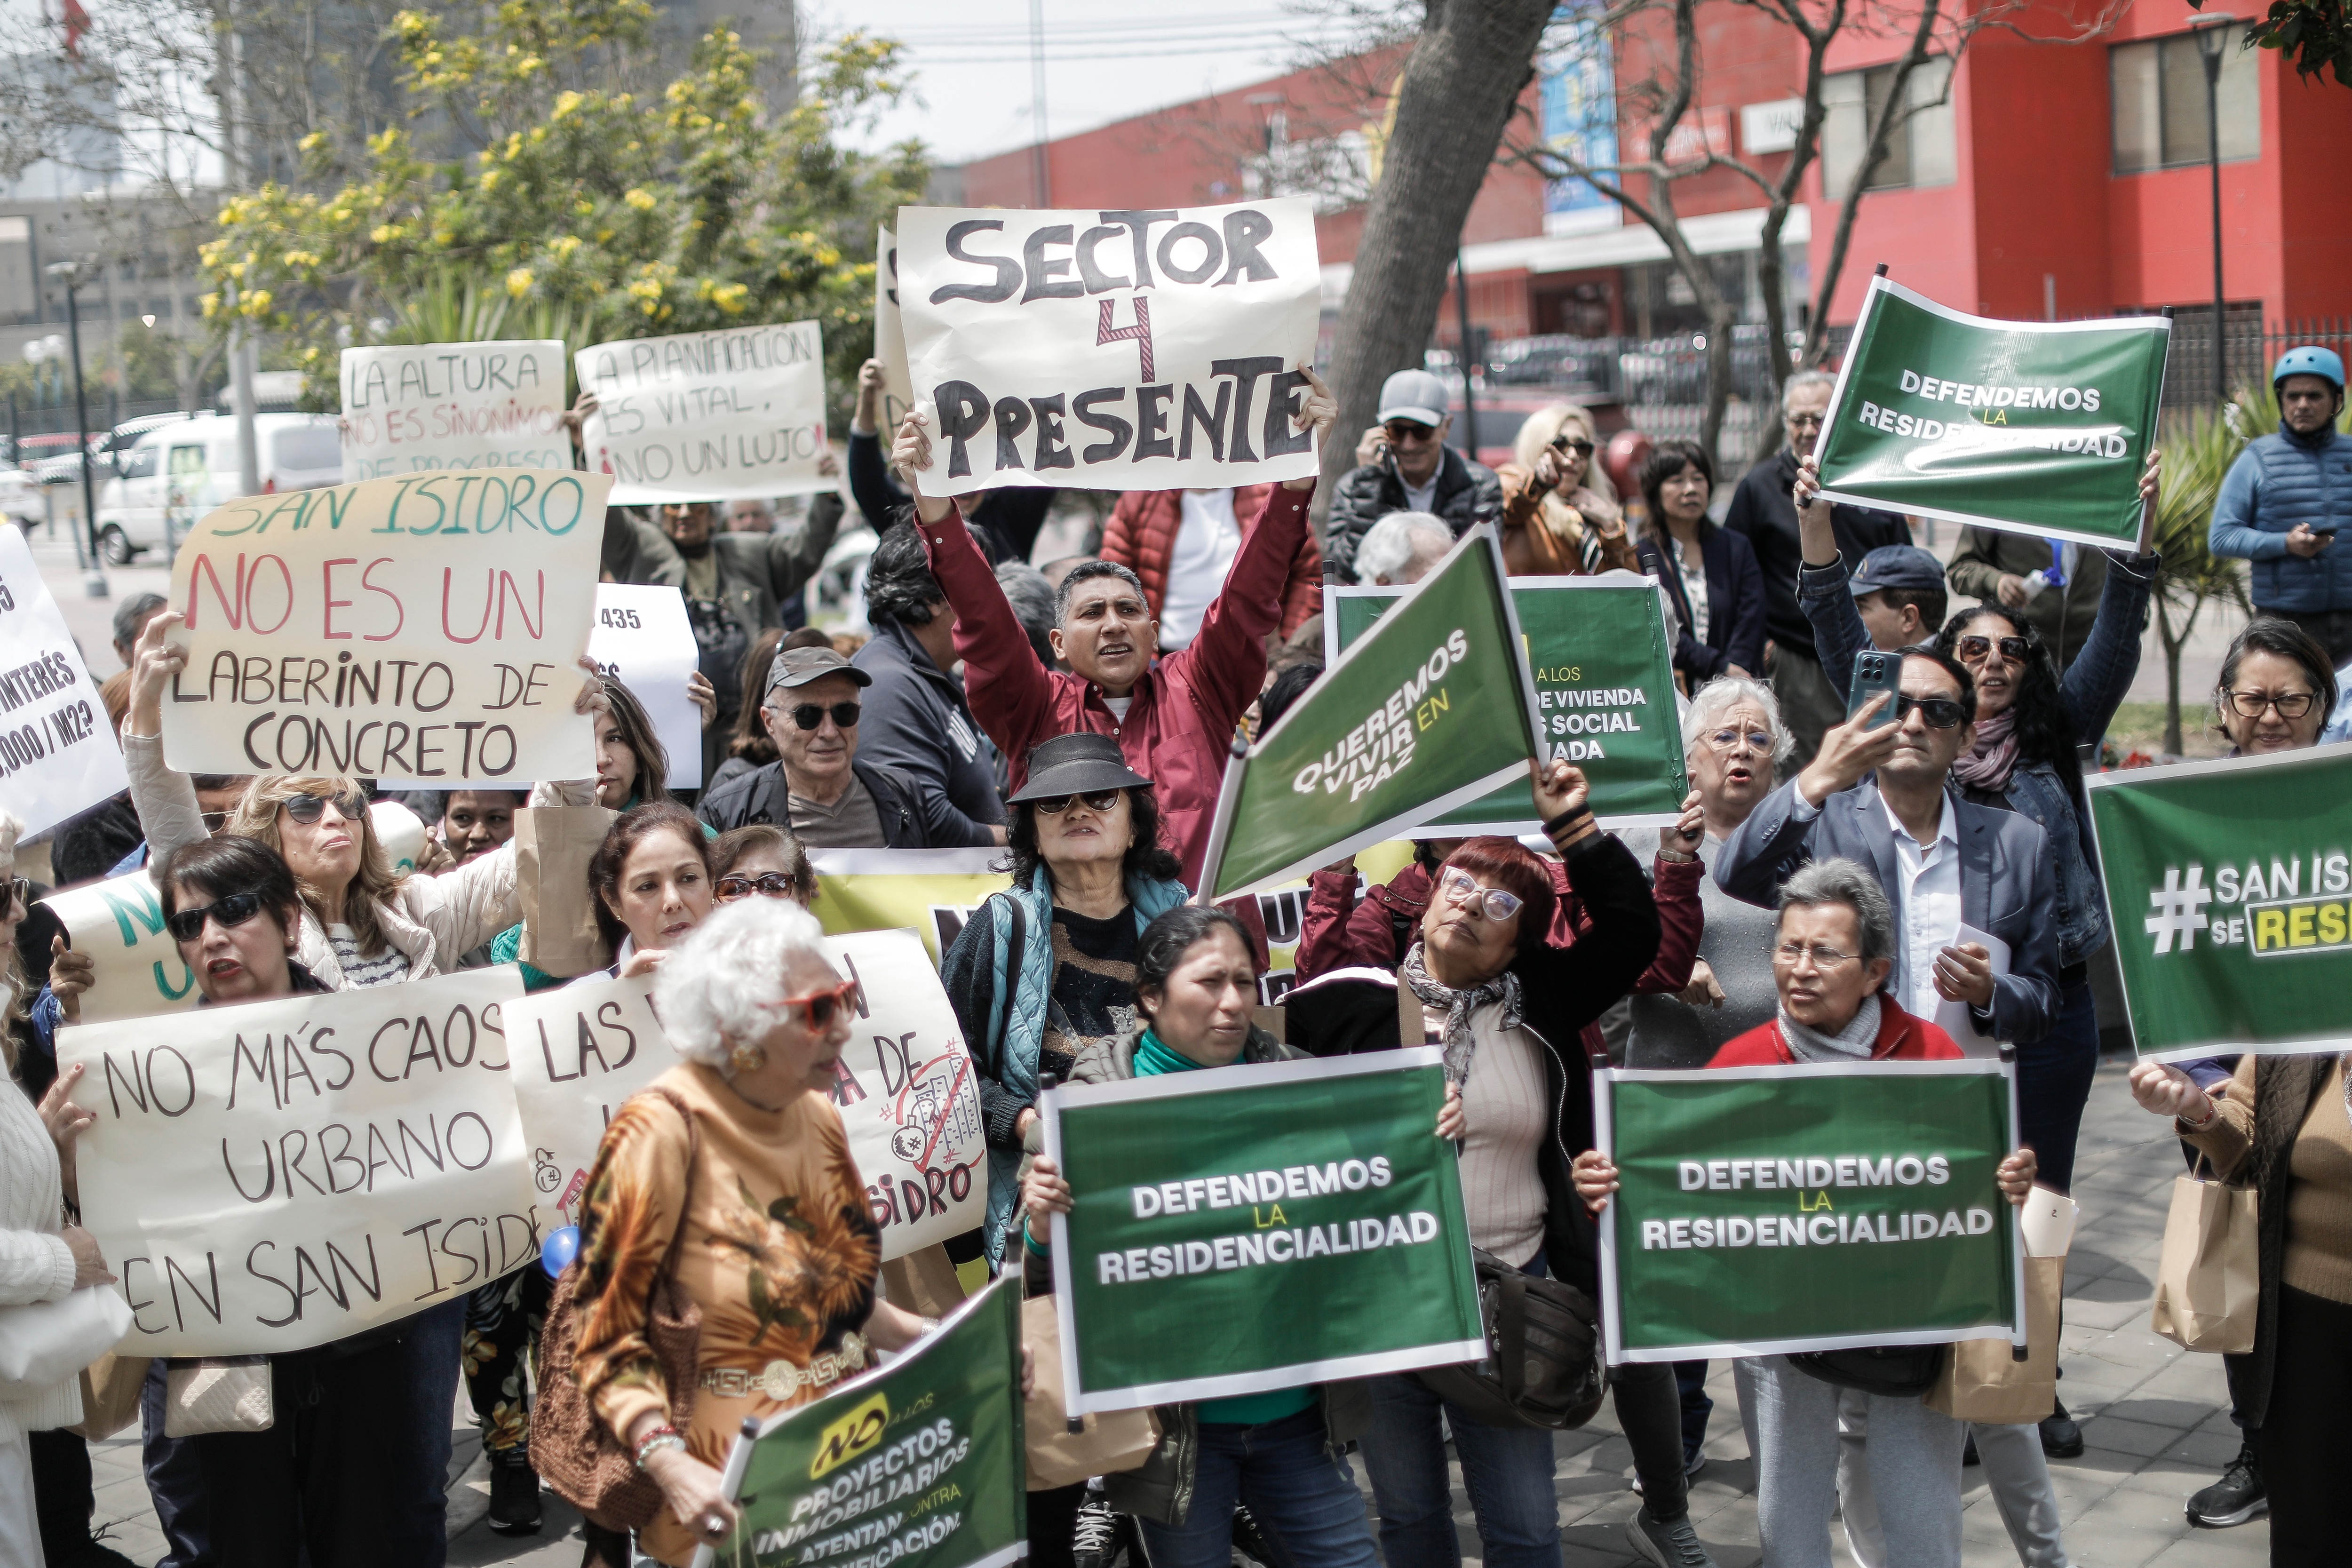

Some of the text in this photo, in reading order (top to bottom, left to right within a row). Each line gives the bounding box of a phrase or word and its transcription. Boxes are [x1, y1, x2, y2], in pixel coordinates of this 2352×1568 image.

[929, 210, 1279, 304] SECTOR
[1097, 296, 1152, 382] 4
[352, 354, 539, 407] LA ALTURA
[1899, 369, 2101, 412] DEFENDEMOS
[342, 413, 377, 448] NO
[387, 409, 425, 443] ES
[600, 396, 645, 437] ES
[933, 356, 1314, 478] PRESENTE
[1983, 408, 2007, 425] LA
[681, 434, 728, 476] UN
[211, 475, 584, 536] SAN ISIDRO
[0, 575, 15, 615] 5
[185, 552, 544, 644] NO ES UN
[601, 608, 641, 629] 435
[481, 663, 556, 709] DE
[1536, 666, 1581, 682] A LOS
[1554, 688, 1646, 708] VIVIENDA
[0, 724, 45, 779] ,000
[48, 699, 94, 748] M2?
[1292, 629, 1469, 794] QUEREMOS
[1323, 687, 1450, 795] VIVIR EN
[1552, 712, 1641, 735] SOCIAL
[244, 711, 517, 778] CONCRETO
[1349, 742, 1417, 803] PAZ
[2215, 860, 2300, 903] SAN
[2313, 855, 2352, 893] IS
[2212, 903, 2352, 950] SE RES
[103, 1003, 510, 1119] NO MÁS CAOS
[537, 1000, 638, 1082] LAS
[873, 1031, 929, 1098] DE
[222, 1111, 493, 1203] URBANO
[1133, 1155, 1392, 1218] DEFENDEMOS
[1679, 1156, 1950, 1191] DEFENDEMOS
[1254, 1203, 1287, 1229] LA
[1643, 1208, 1994, 1250] RESIDENCIALIDAD
[1800, 1191, 1833, 1211] LA
[1098, 1210, 1438, 1285] RESIDENCIALIDAD
[123, 1250, 221, 1334] EN
[245, 1234, 381, 1328] SAN
[814, 1409, 887, 1472] NO
[903, 1391, 934, 1420] LOS
[756, 1437, 970, 1555] INMOBILIARIOS
[791, 1417, 953, 1523] PROYECTOS
[800, 1483, 962, 1565] ATENTAN CONTRA
[828, 1512, 961, 1568] IFICACIÓN.
